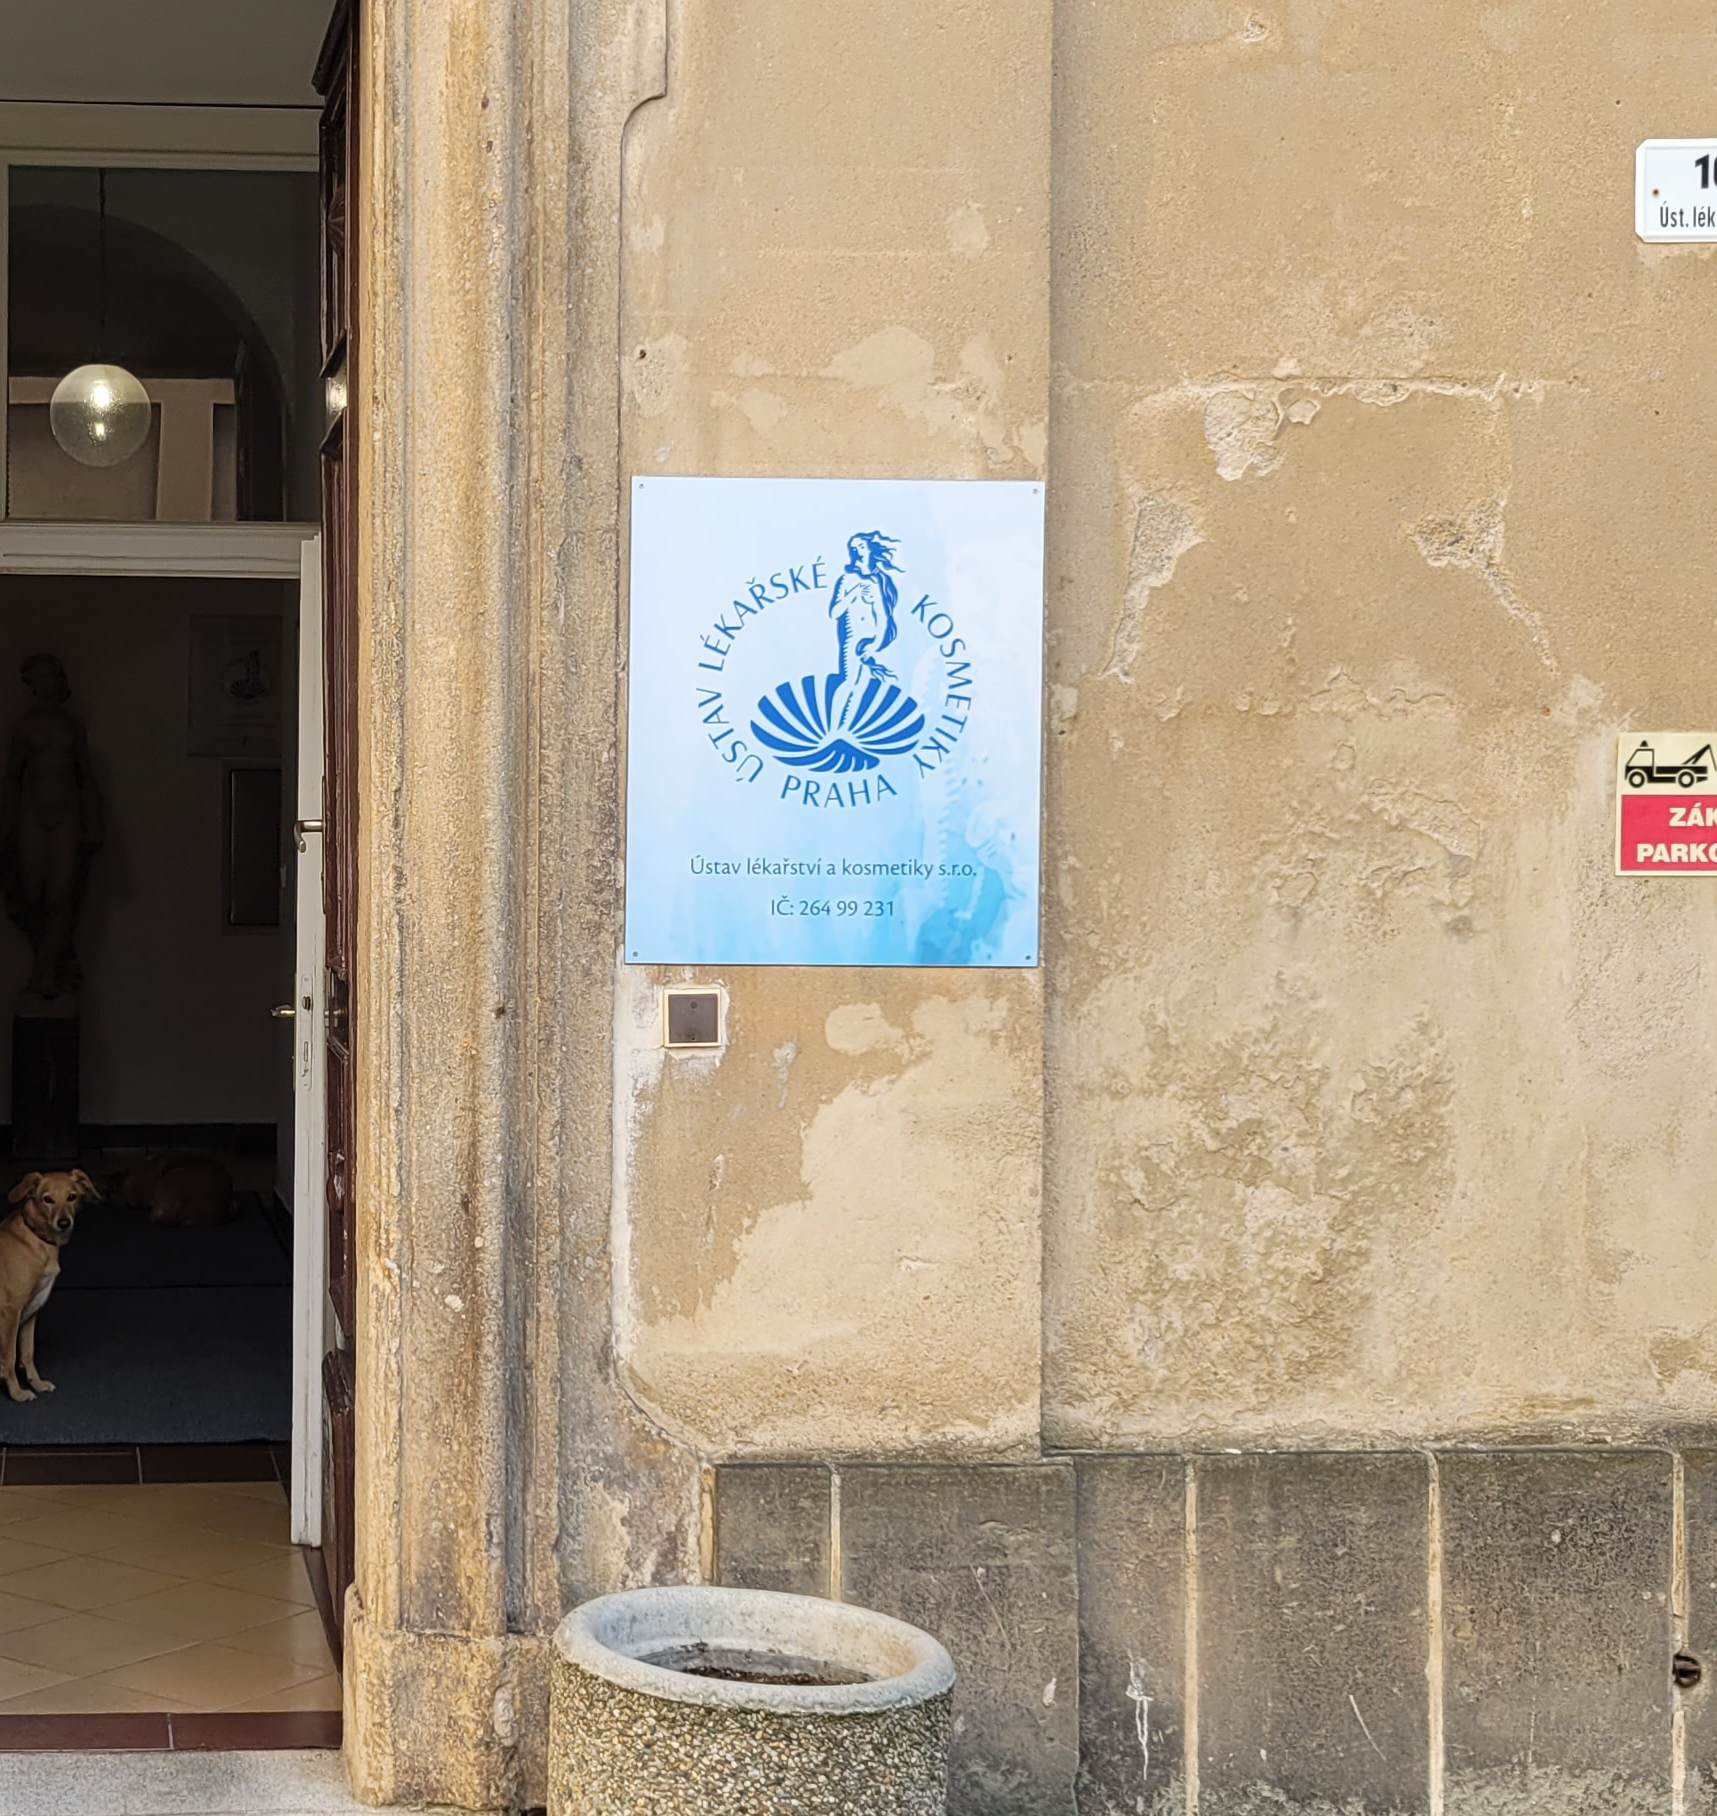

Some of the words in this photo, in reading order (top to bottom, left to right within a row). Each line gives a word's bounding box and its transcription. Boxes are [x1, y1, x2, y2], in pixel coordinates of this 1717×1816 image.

[1659, 200, 1689, 228] Úst.
[697, 555, 829, 672] LÉKAŘSKÉ
[910, 593, 973, 779] KOSMETIKY
[696, 686, 764, 784] ÚSTAV
[780, 774, 898, 808] PRAHA
[690, 855, 741, 876] Ústav
[747, 857, 821, 876] lékařství
[827, 862, 836, 876] a
[842, 858, 933, 880] kosmetiky
[938, 861, 977, 877] s.r.o.
[771, 895, 794, 917] IČ:
[799, 900, 831, 917] 264
[837, 900, 858, 917] 99
[864, 900, 894, 917] 231
